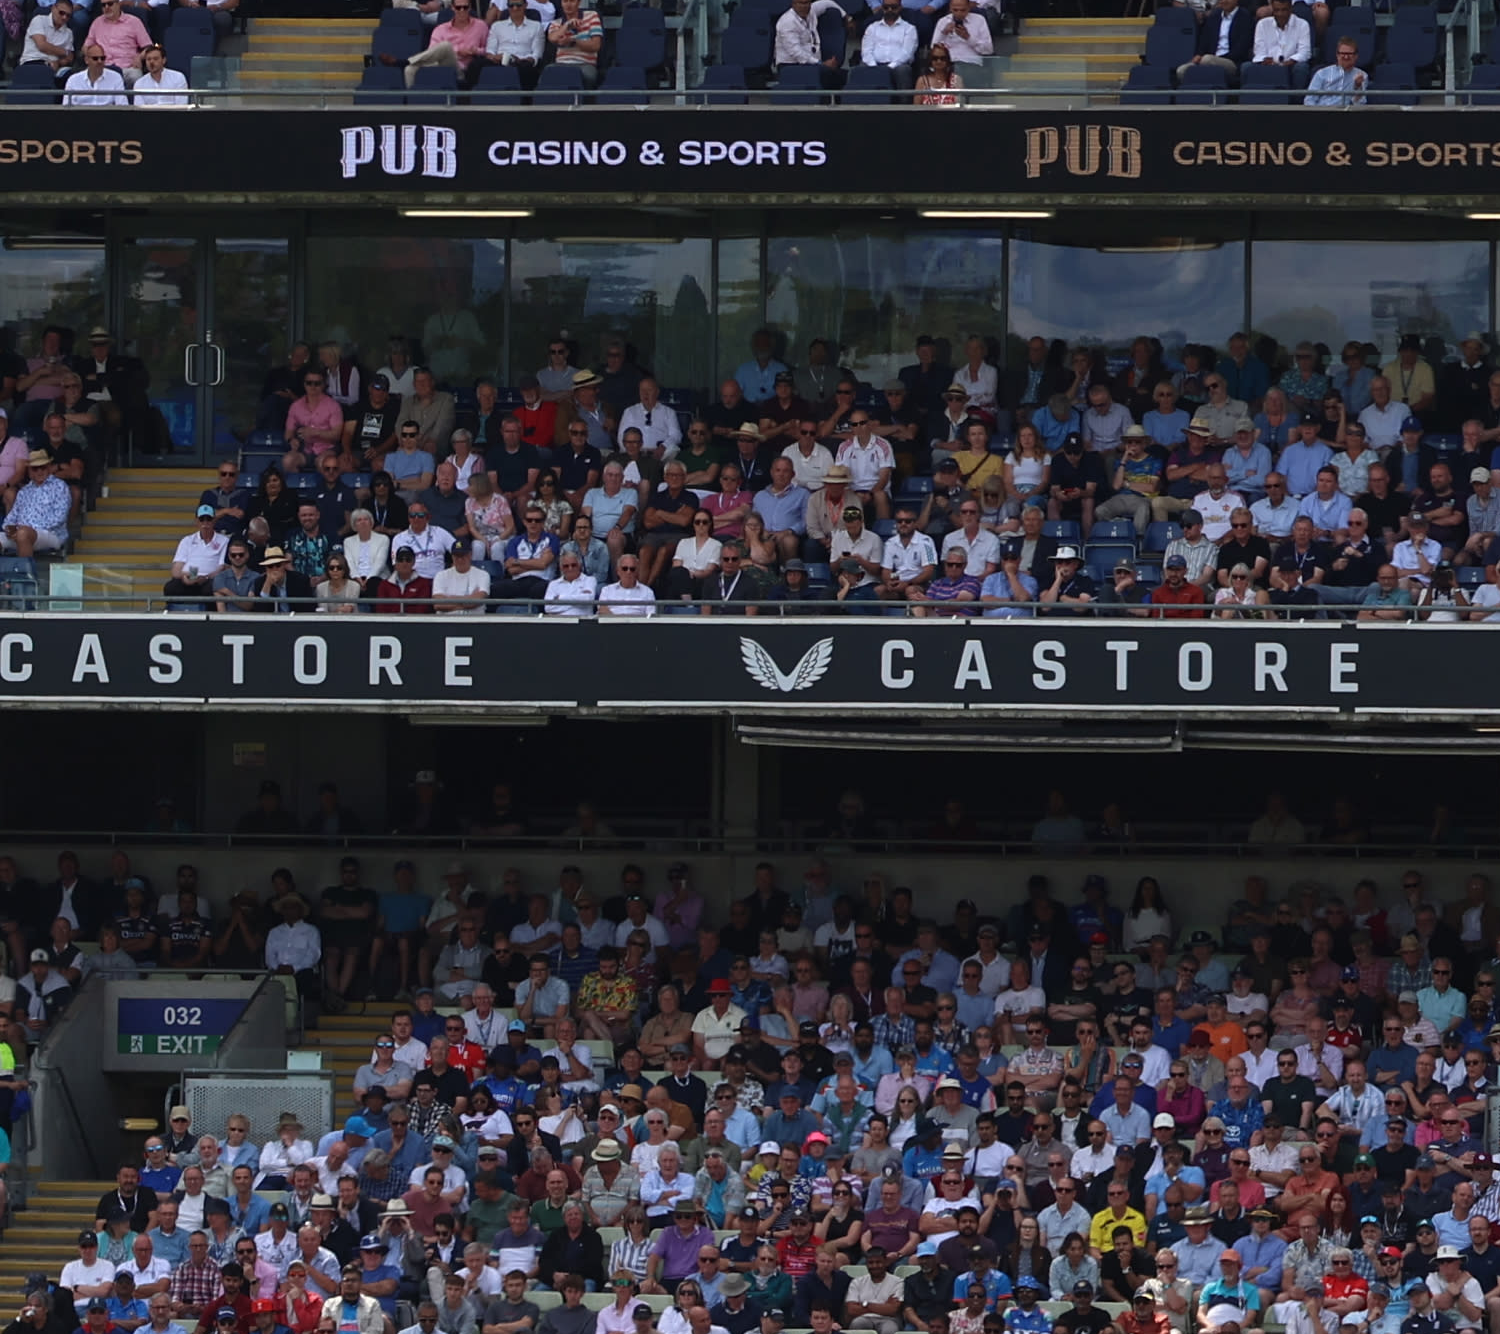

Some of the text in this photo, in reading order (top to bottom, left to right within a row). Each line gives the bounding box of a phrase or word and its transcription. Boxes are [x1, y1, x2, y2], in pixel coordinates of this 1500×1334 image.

[340, 125, 827, 178] PUB CASINO & SPORTS
[1025, 125, 1141, 178] PUB
[1174, 142, 1312, 165] CASINO
[1326, 142, 1351, 166] &
[0, 634, 472, 685] CASTORE
[881, 640, 1358, 692] CASTORE
[164, 1006, 201, 1026] 032
[157, 1035, 207, 1055] EXIT
